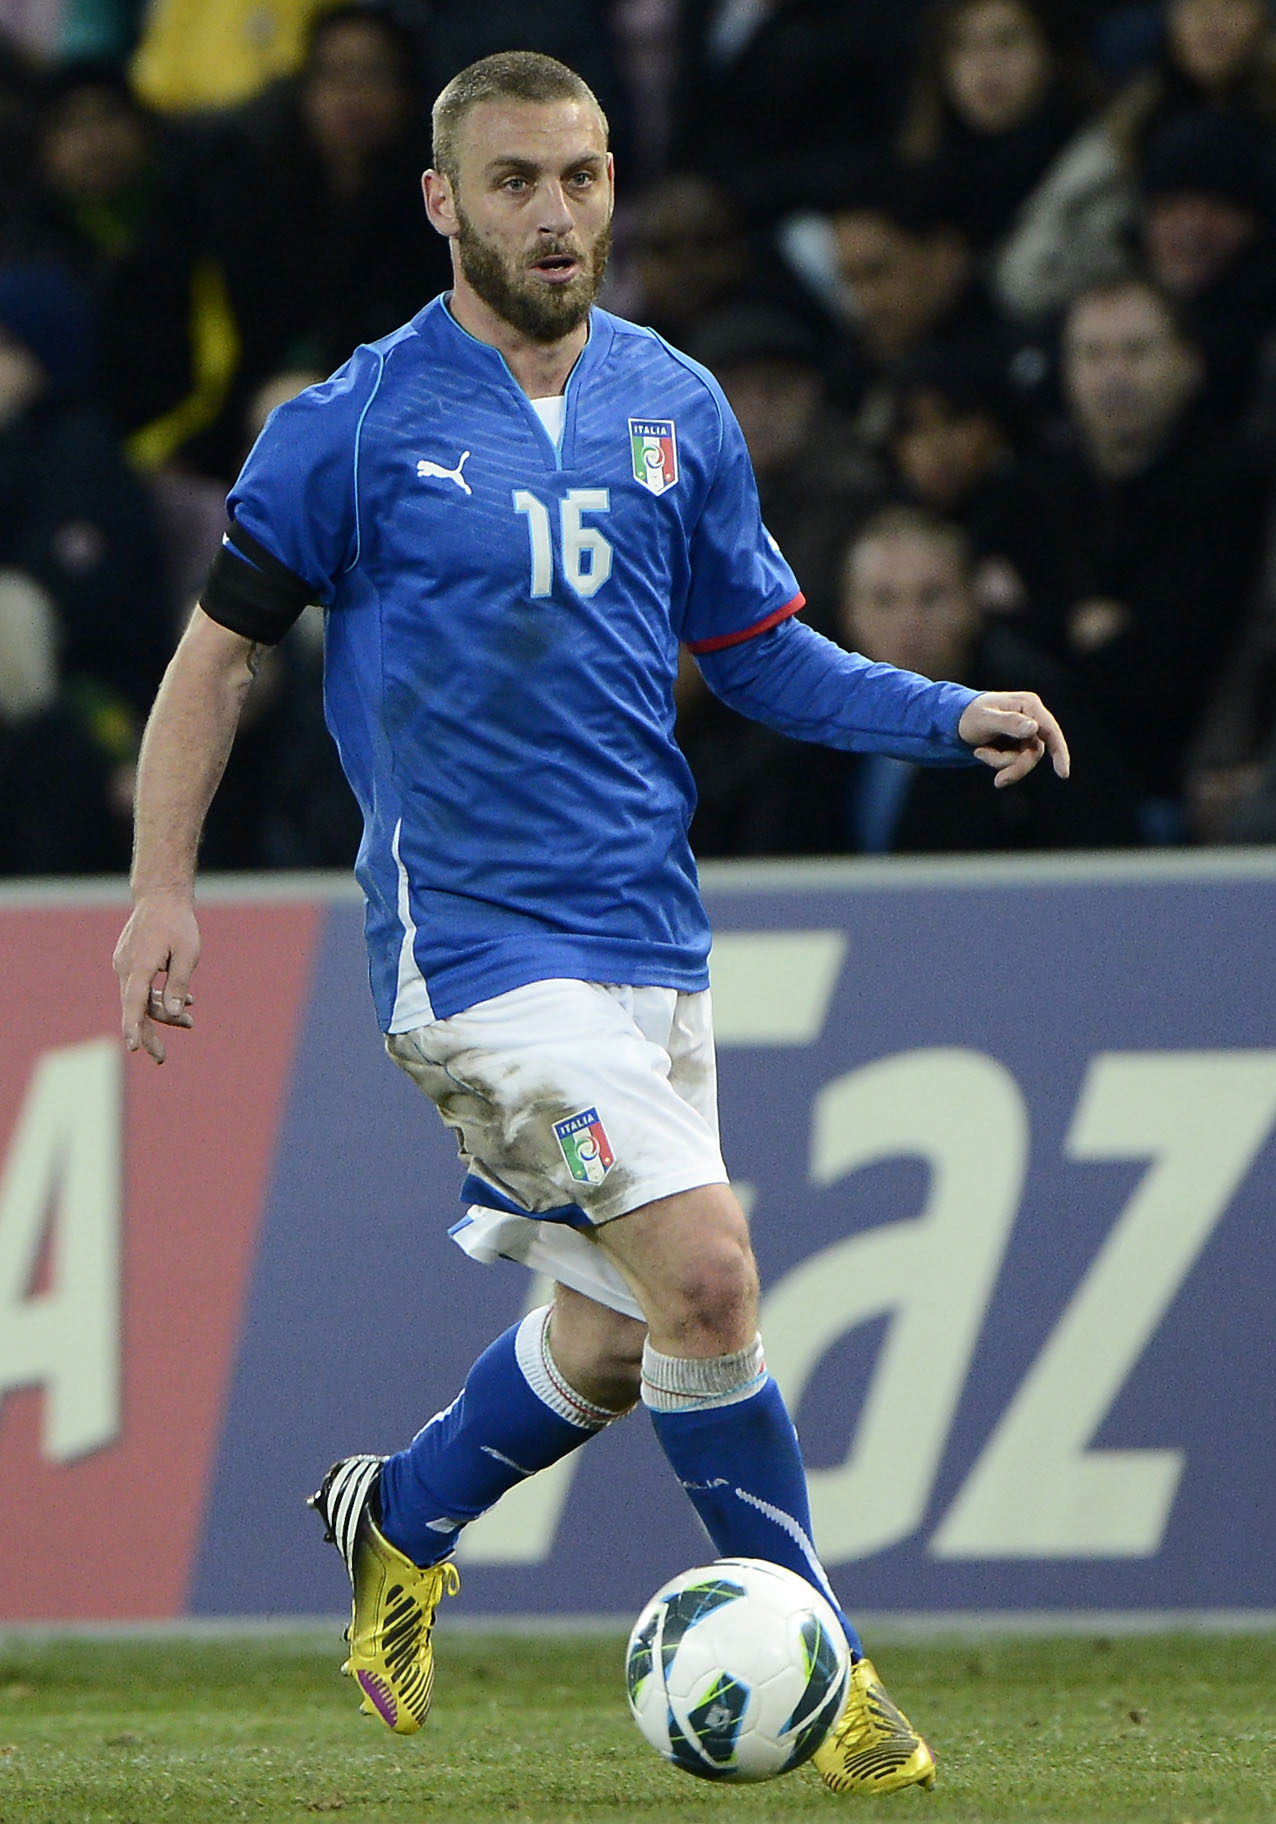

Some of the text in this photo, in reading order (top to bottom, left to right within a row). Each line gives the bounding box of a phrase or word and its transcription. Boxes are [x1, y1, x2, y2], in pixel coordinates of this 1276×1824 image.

[633, 425, 667, 436] ITALIA
[512, 488, 614, 599] 16
[560, 1113, 595, 1135] ITALIA
